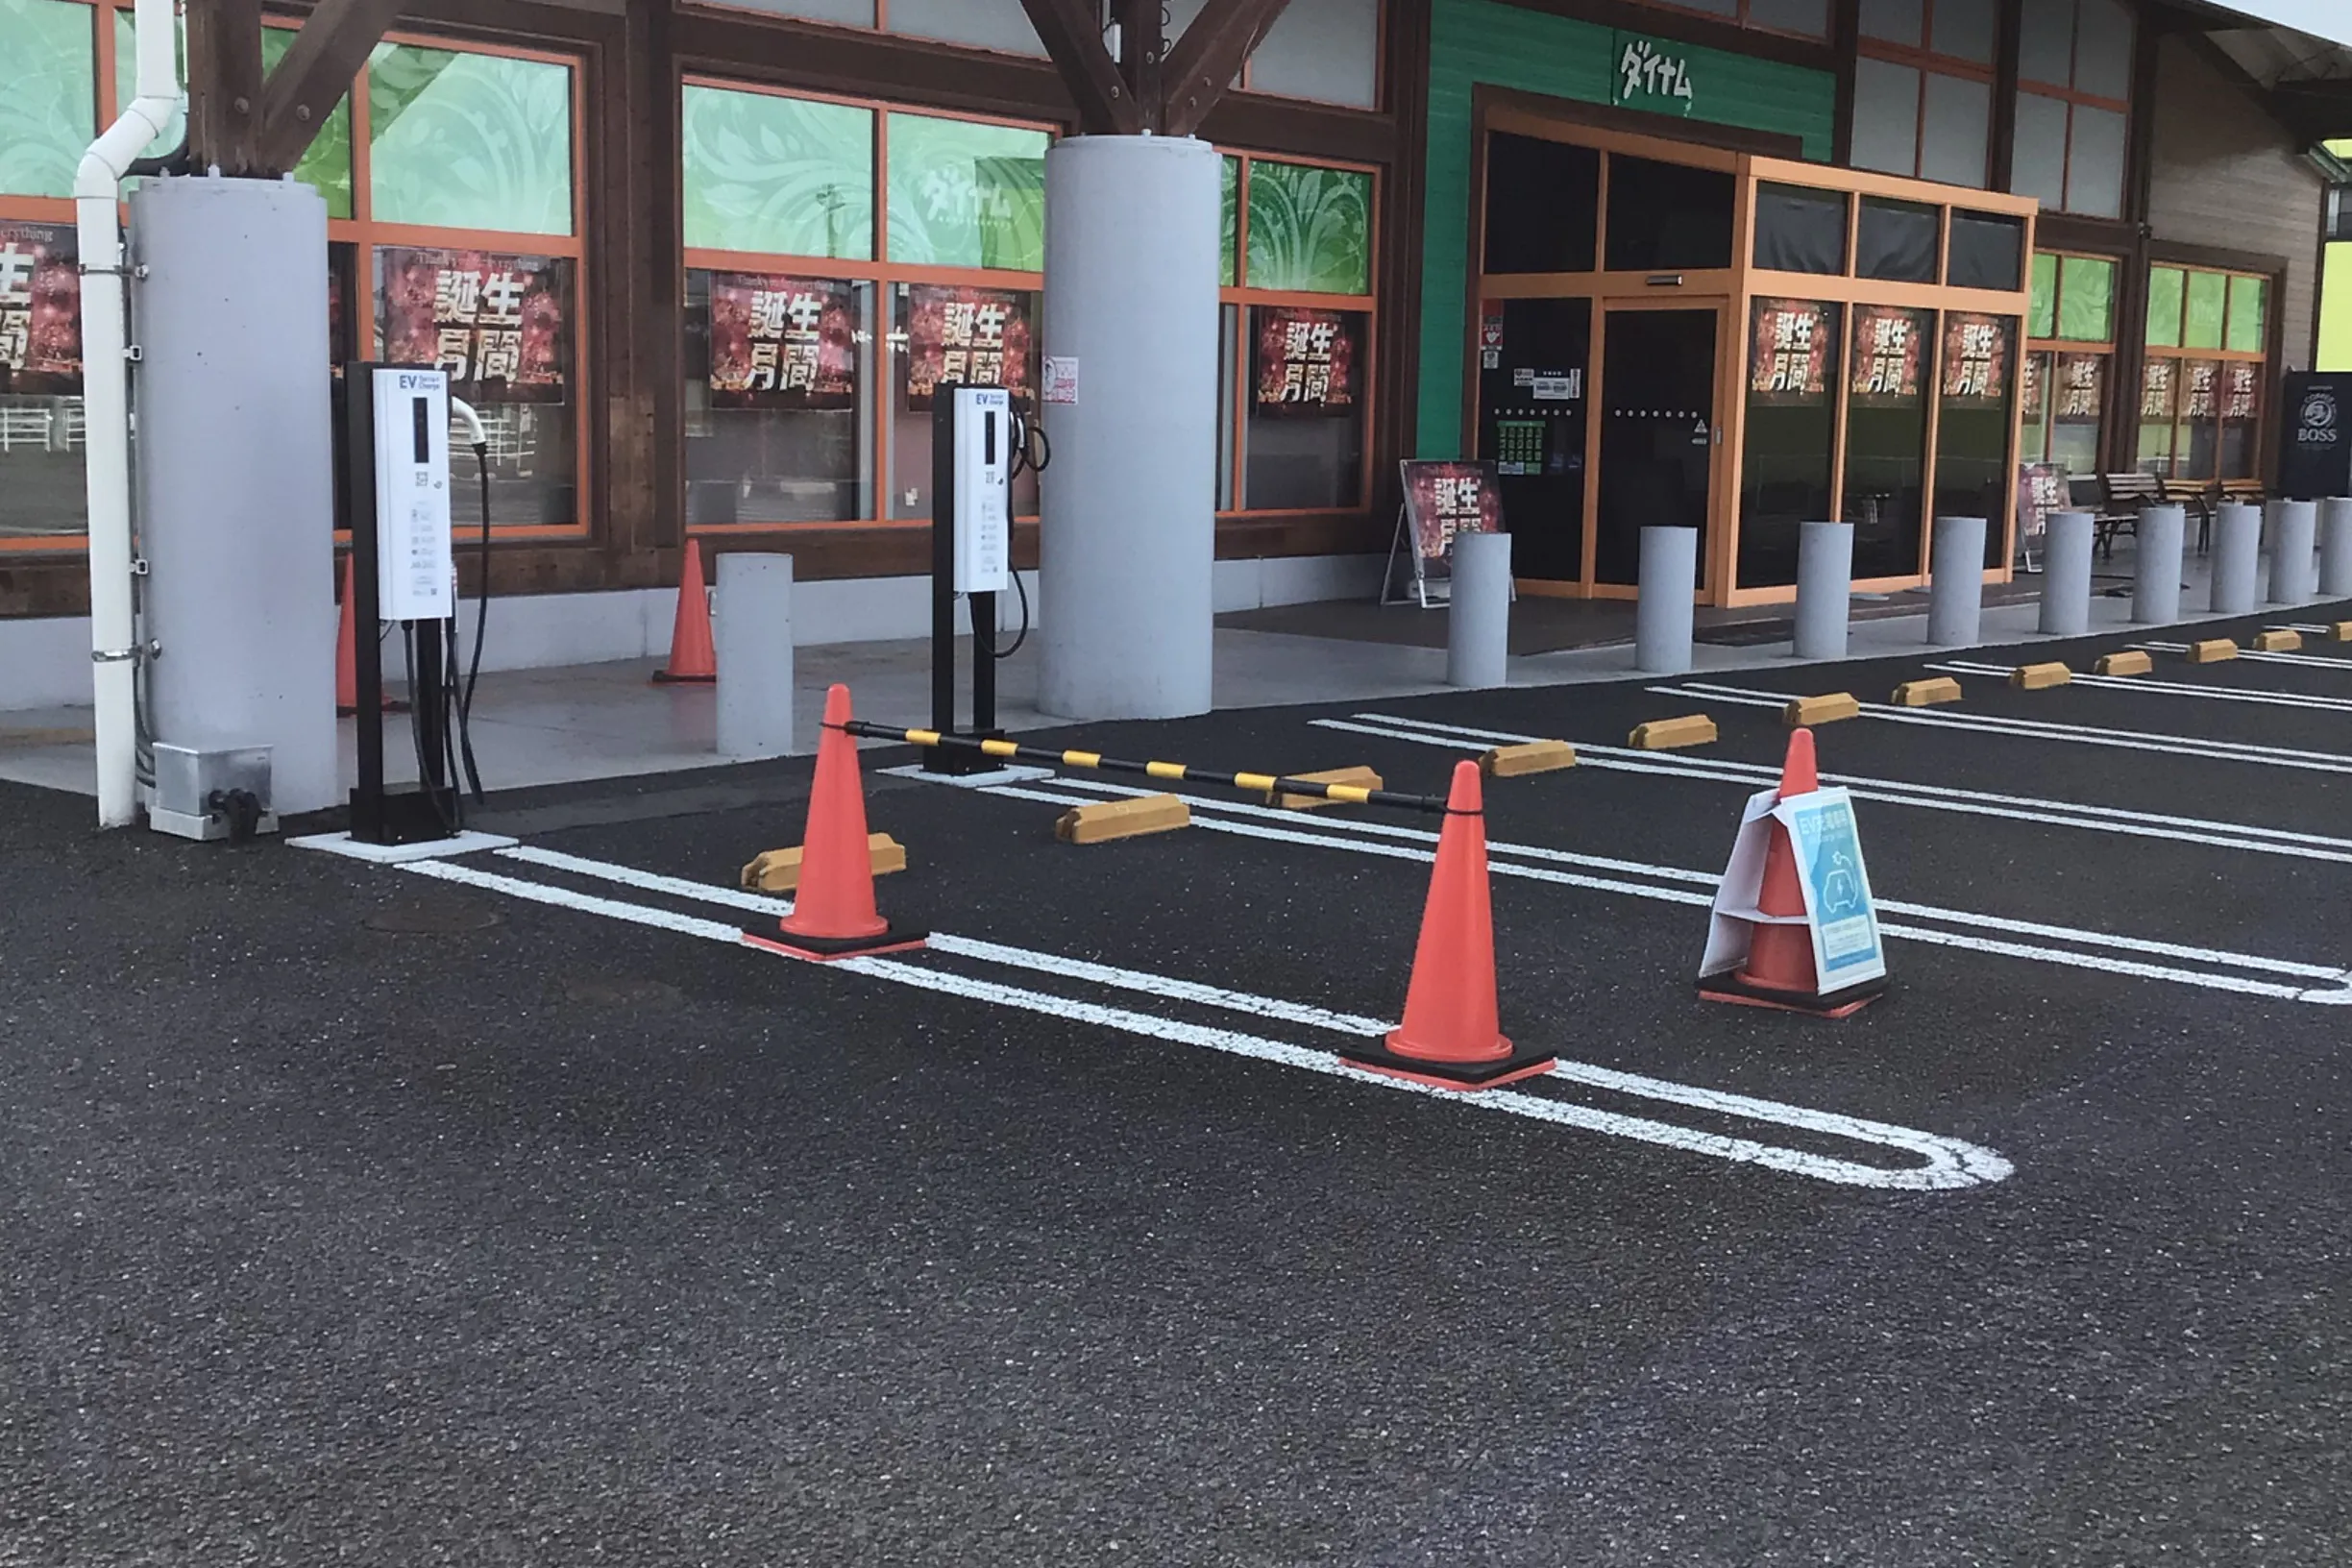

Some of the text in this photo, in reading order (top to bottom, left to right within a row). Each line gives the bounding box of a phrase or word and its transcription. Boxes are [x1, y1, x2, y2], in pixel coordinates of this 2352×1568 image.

[1621, 40, 1692, 99] ダイナム
[921, 170, 1012, 221] ダイナム
[433, 270, 525, 327] 誕生
[747, 291, 822, 340] 誕生
[941, 303, 1005, 347] 誕生
[1284, 322, 1334, 361] 誕生
[1774, 312, 1814, 350] 誕生
[1873, 318, 1910, 355] 誕生
[1961, 324, 1996, 357] 誕生
[434, 329, 523, 382] 月間
[743, 343, 820, 391] 月間
[1770, 353, 1810, 390] 月間
[399, 375, 417, 389] EV
[976, 393, 989, 405] EV
[1280, 364, 1331, 402] 月間
[2297, 429, 2337, 442] BOSS
[1434, 478, 1481, 515] 誕生
